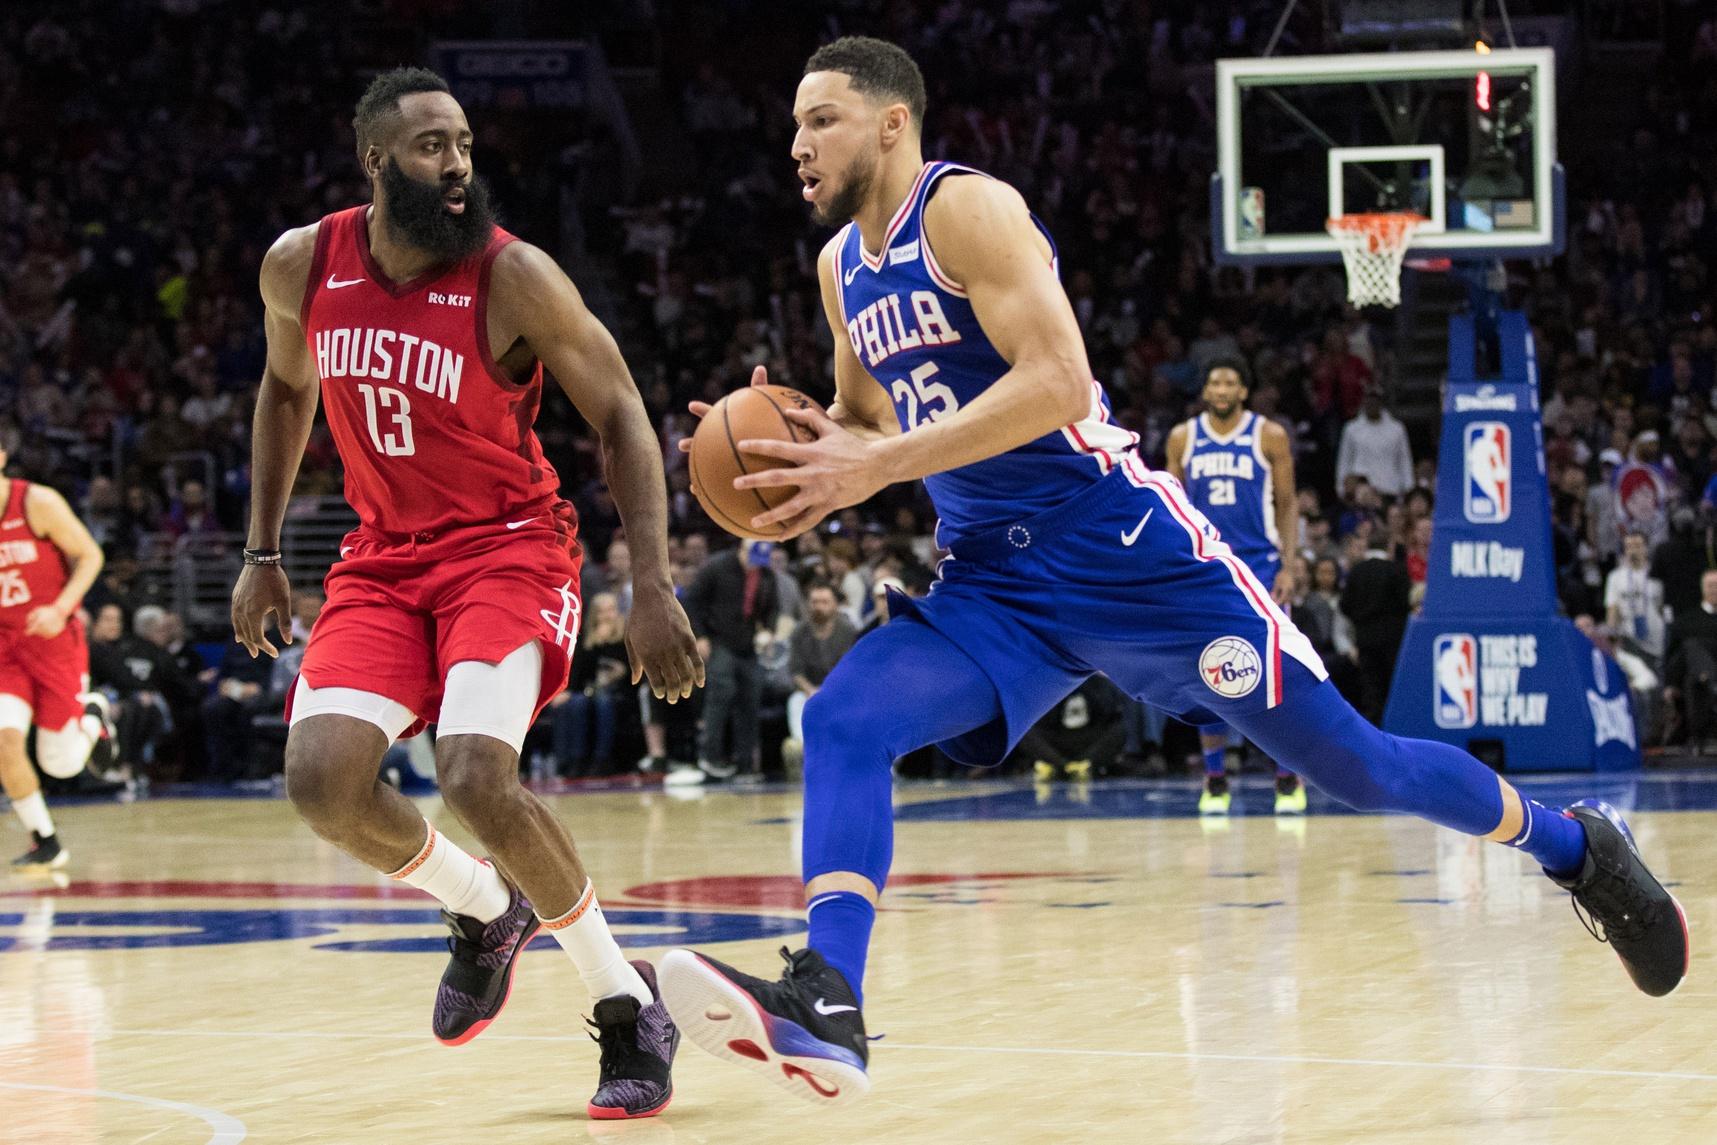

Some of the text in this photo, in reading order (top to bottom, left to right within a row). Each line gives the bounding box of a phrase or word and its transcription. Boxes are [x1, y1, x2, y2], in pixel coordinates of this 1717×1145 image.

[848, 290, 962, 368] PHILA
[316, 328, 464, 404] HOUSTON
[358, 384, 415, 457] 13
[891, 360, 959, 434] 25
[1191, 452, 1254, 480] PHILA
[1208, 479, 1237, 505] 21
[1451, 541, 1524, 583] MLK Day
[1207, 661, 1257, 685] 76ers
